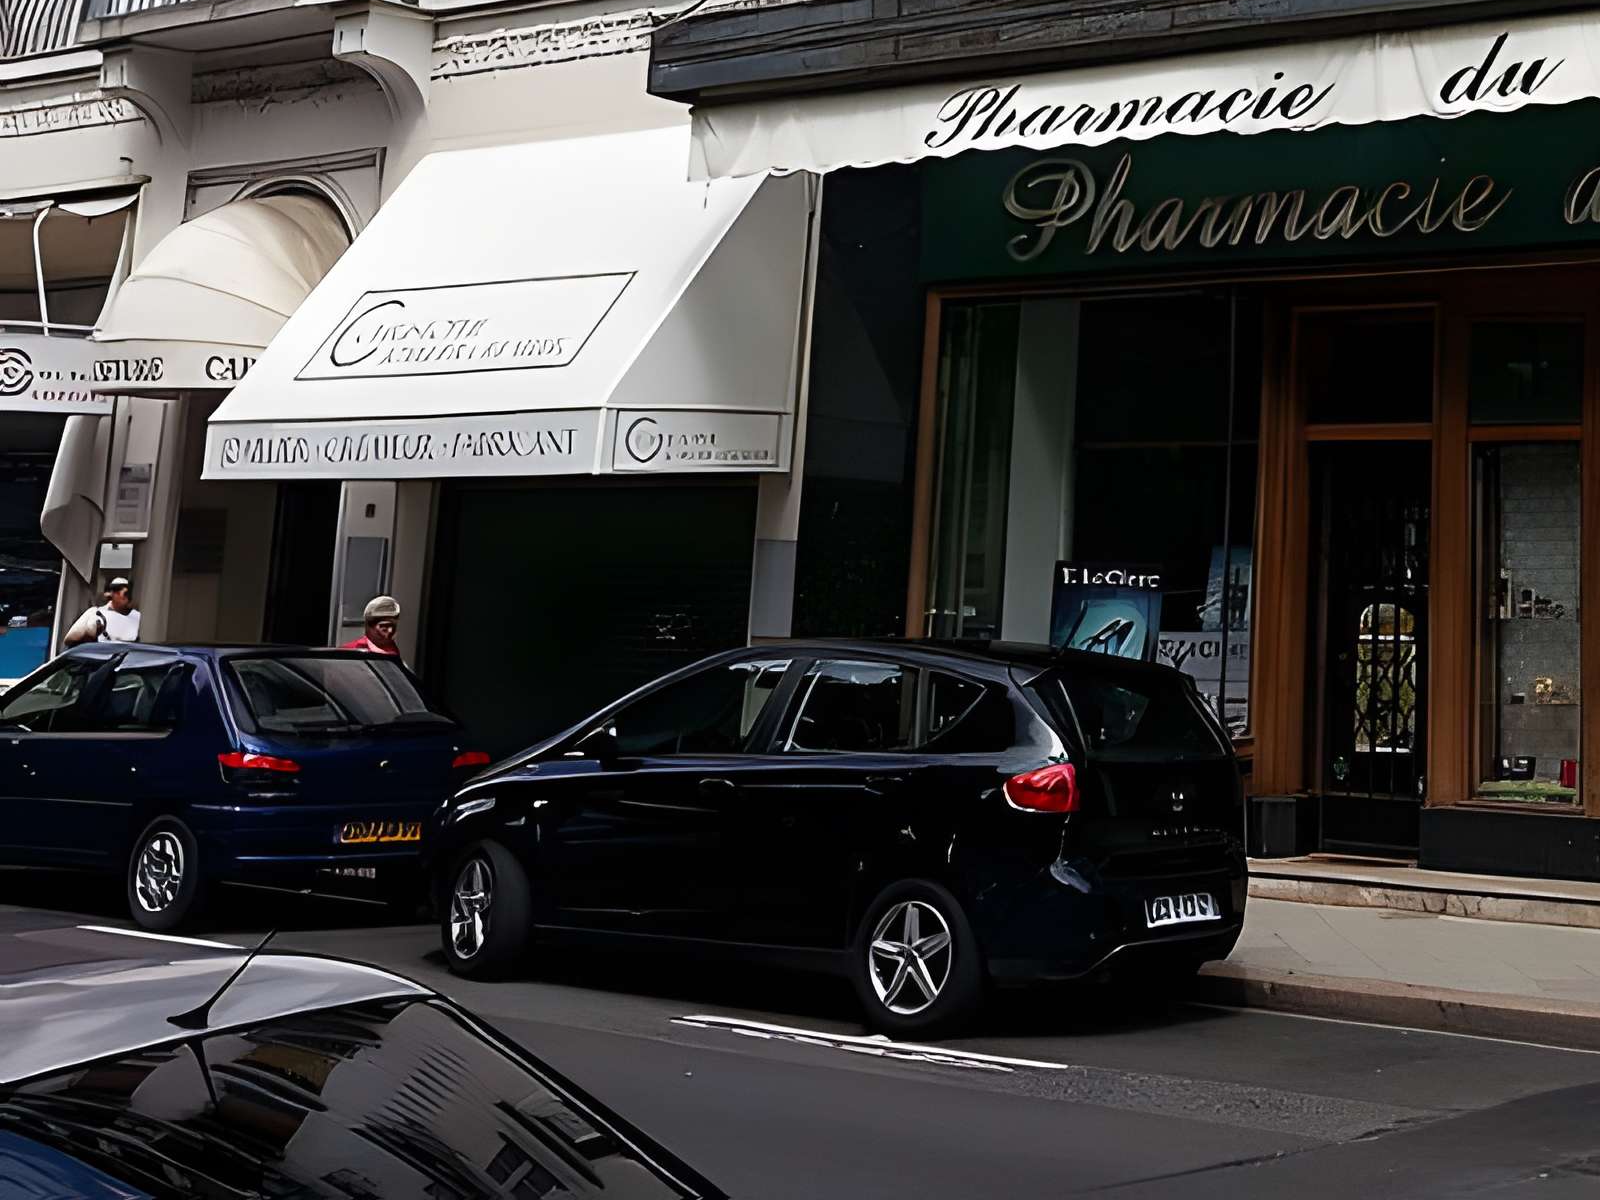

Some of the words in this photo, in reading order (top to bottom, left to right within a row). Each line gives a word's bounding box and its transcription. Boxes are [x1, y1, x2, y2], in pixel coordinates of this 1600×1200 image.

[923, 70, 1337, 149] Pharmacie
[1439, 31, 1566, 105] du
[1002, 152, 1514, 263] Pharmacie
